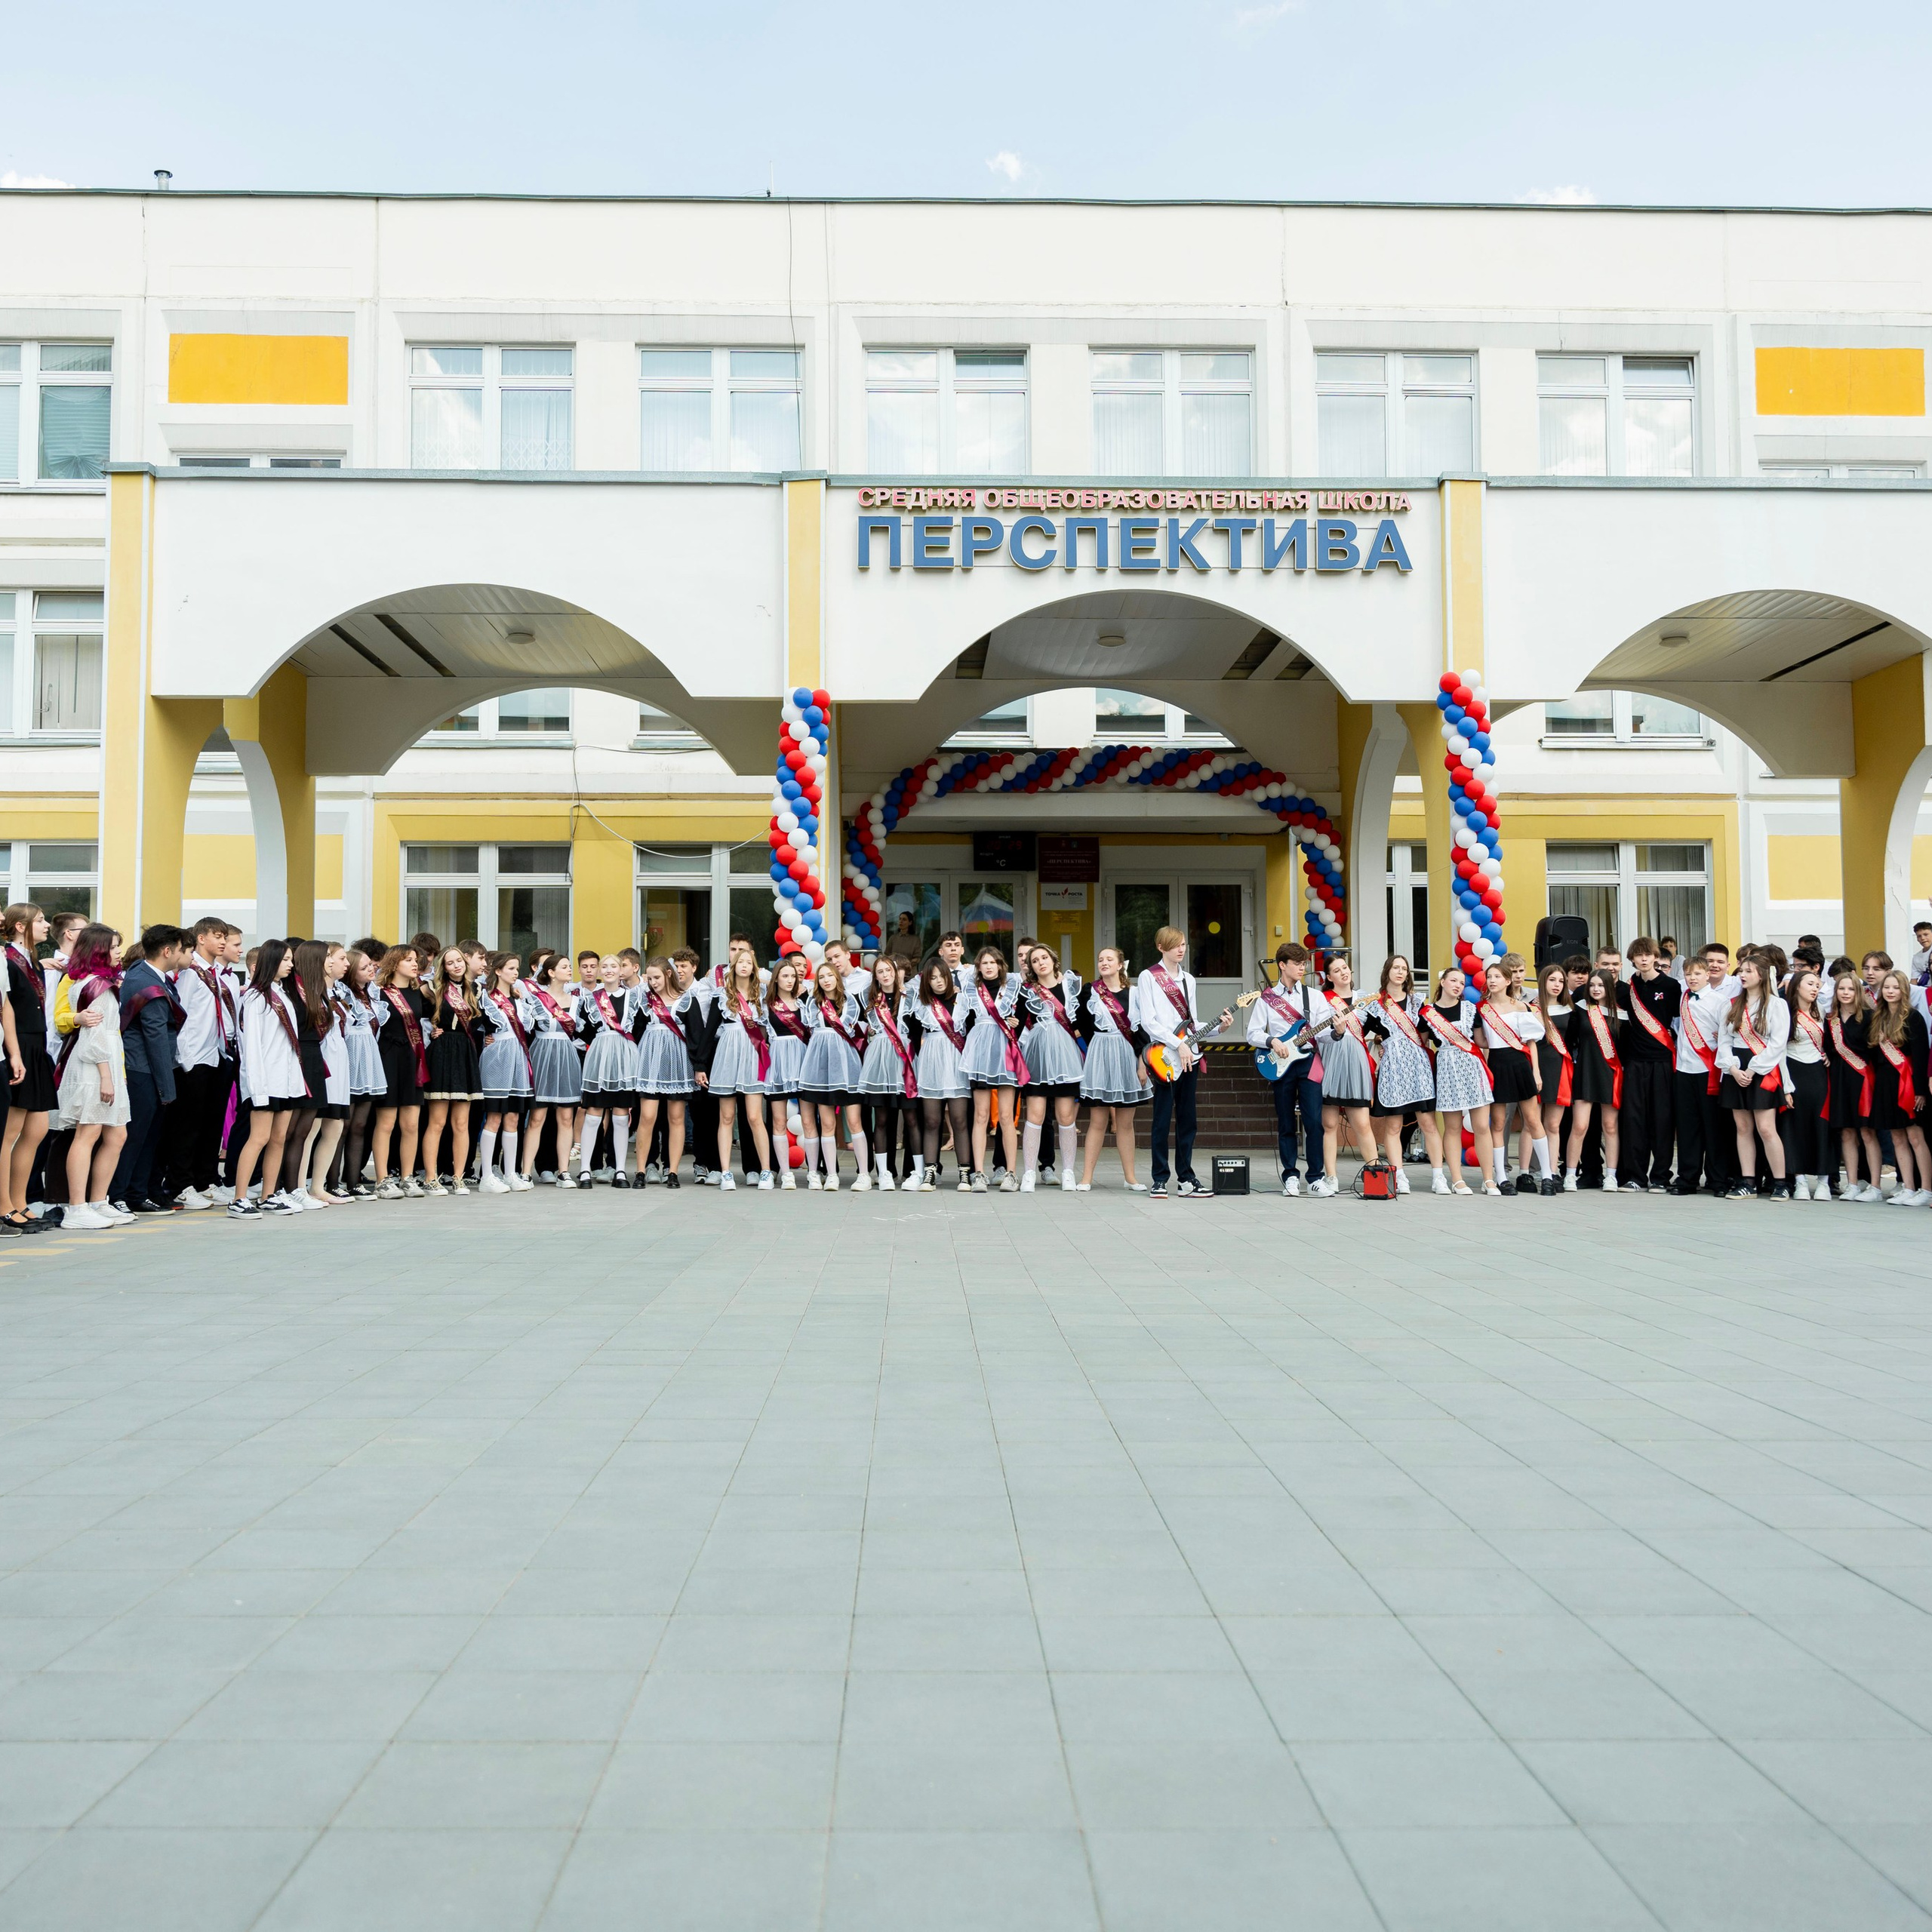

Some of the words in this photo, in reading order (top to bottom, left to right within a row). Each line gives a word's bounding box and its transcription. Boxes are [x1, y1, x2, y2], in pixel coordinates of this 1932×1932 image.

[857, 488, 976, 510] СРЕДНЯЯ
[983, 488, 1311, 511] ОБЩЕОБРАЗОВАТЕЛЬНАЯ
[1317, 491, 1413, 512] ШКОЛА
[857, 515, 1414, 573] ПЕРСПЕКТИВА
